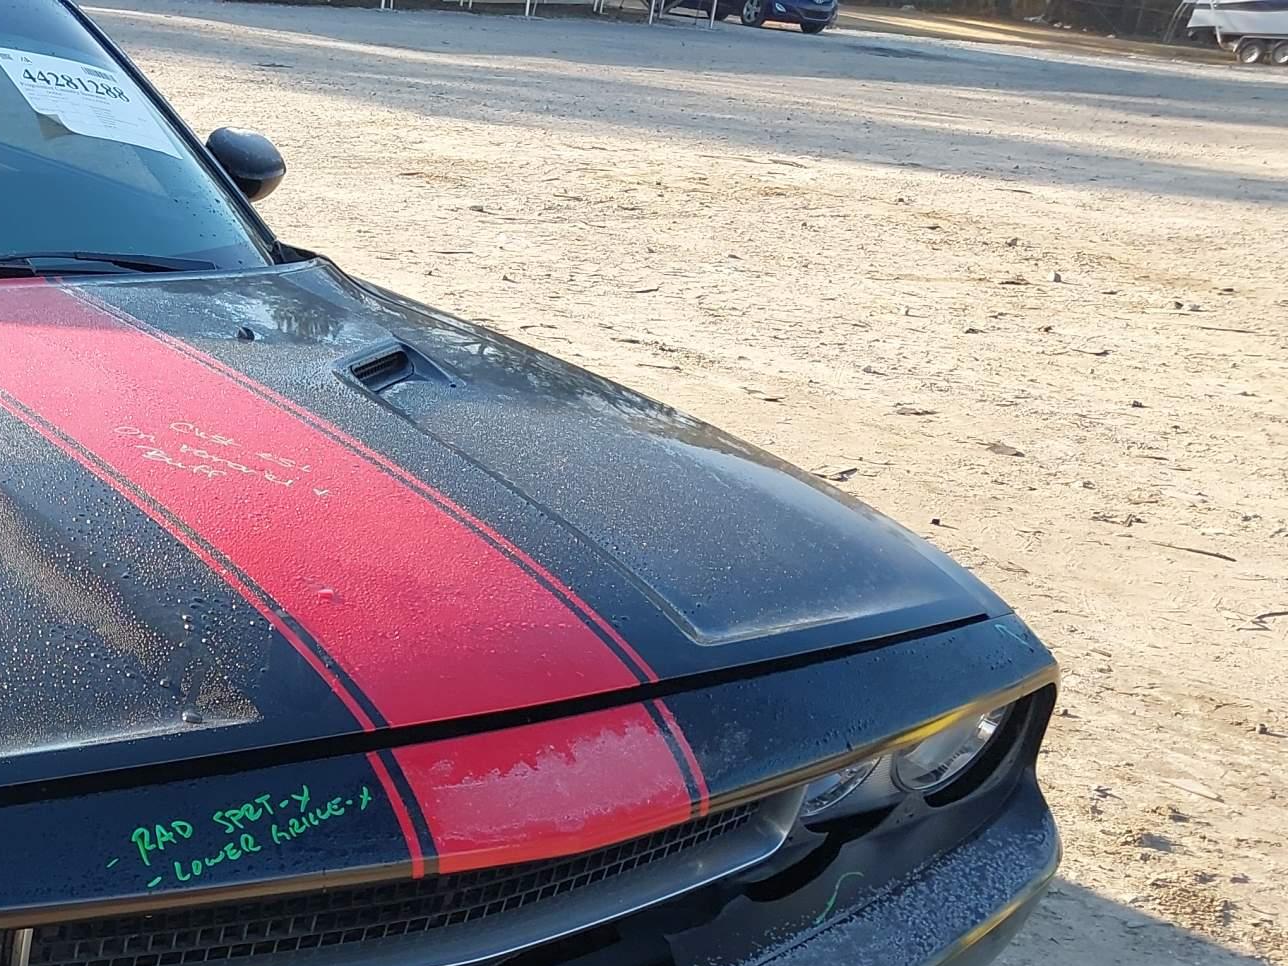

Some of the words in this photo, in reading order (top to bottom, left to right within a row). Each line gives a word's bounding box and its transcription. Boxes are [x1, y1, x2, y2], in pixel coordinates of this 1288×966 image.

[22, 69, 130, 102] 44281288
[131, 820, 193, 866] RAD
[174, 834, 262, 881] LOWER
